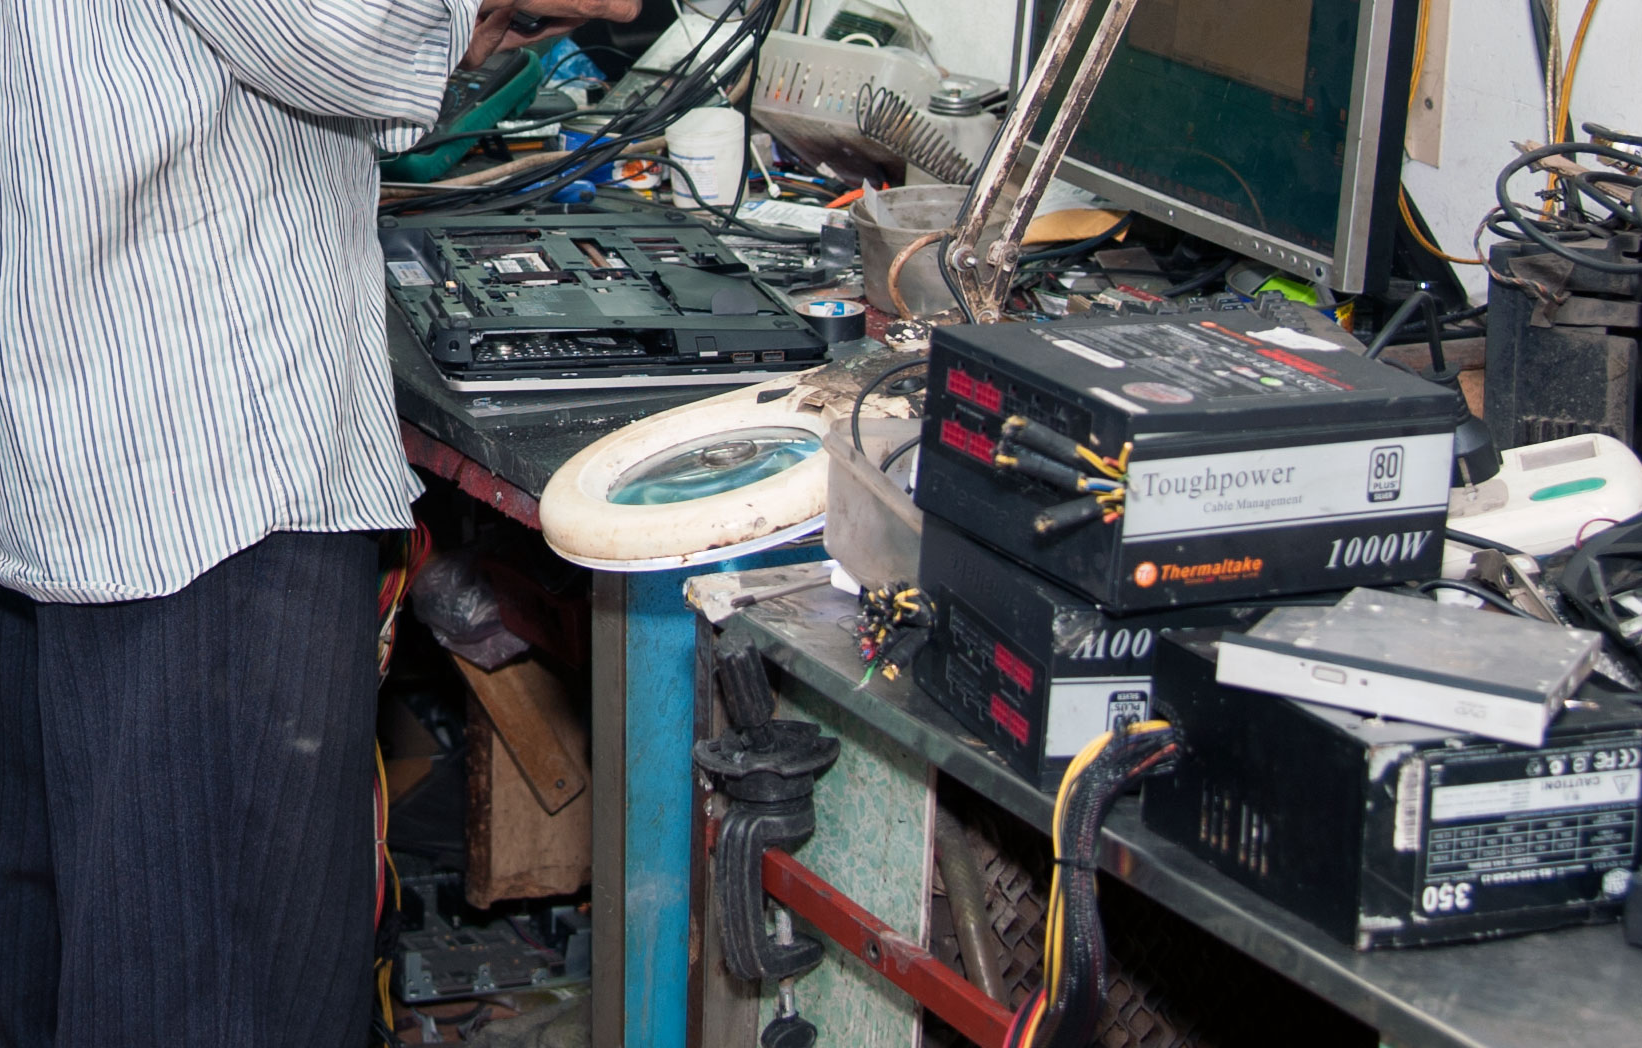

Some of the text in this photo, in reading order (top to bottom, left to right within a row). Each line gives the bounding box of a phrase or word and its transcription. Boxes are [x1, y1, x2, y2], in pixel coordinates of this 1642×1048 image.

[1373, 451, 1399, 480] 80
[1142, 465, 1296, 500] Toughpower
[1373, 479, 1396, 490] PLUS
[1203, 494, 1303, 514] Cable Management
[1324, 529, 1434, 571] 1000W
[1160, 556, 1264, 582] Thermaltake
[1069, 626, 1172, 660] 00W
[1114, 702, 1141, 713] PLUS
[1421, 882, 1473, 912] 350
